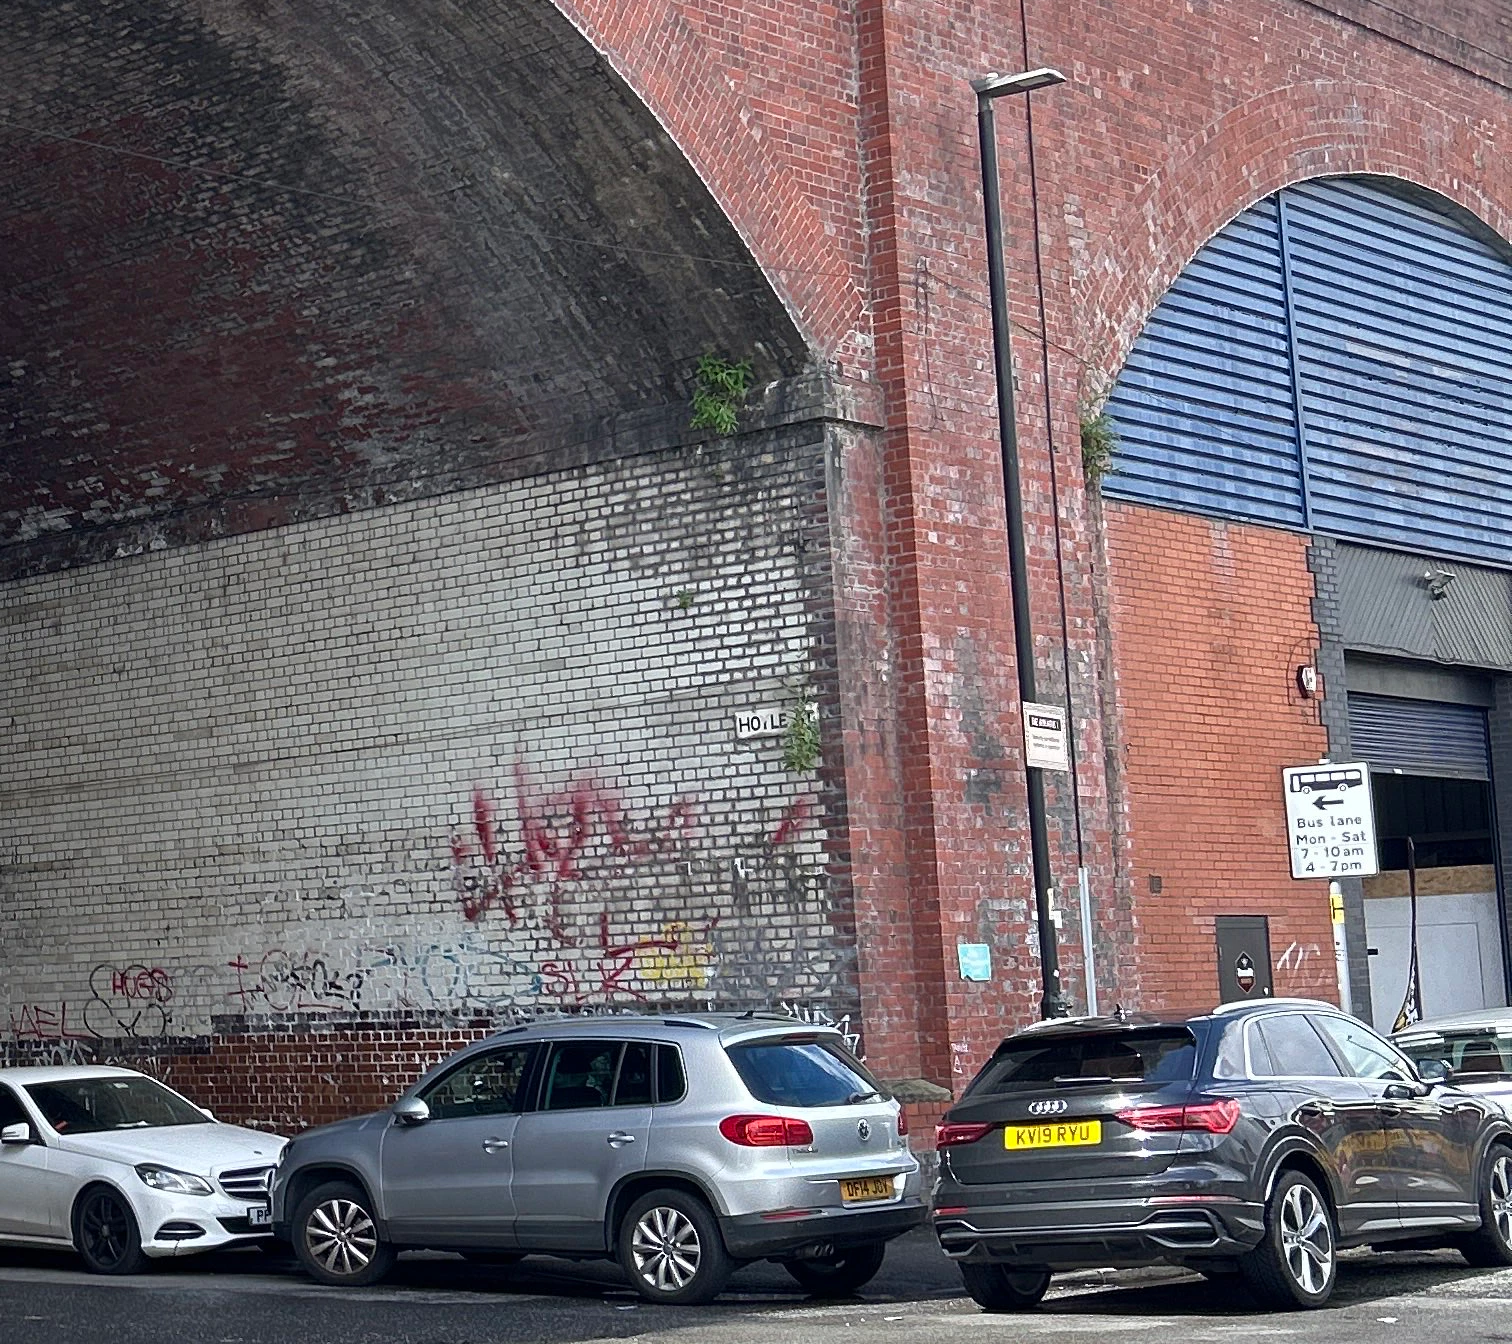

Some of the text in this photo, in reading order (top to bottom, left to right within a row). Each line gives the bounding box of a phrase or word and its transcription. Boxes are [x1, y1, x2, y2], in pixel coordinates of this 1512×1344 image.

[1297, 816, 1362, 828] Bus lane
[1296, 835, 1326, 845] Mon
[1341, 830, 1367, 843] Sat
[1301, 847, 1309, 859] 7
[1305, 861, 1315, 873] 4
[1016, 1125, 1090, 1145] KV19 RYU
